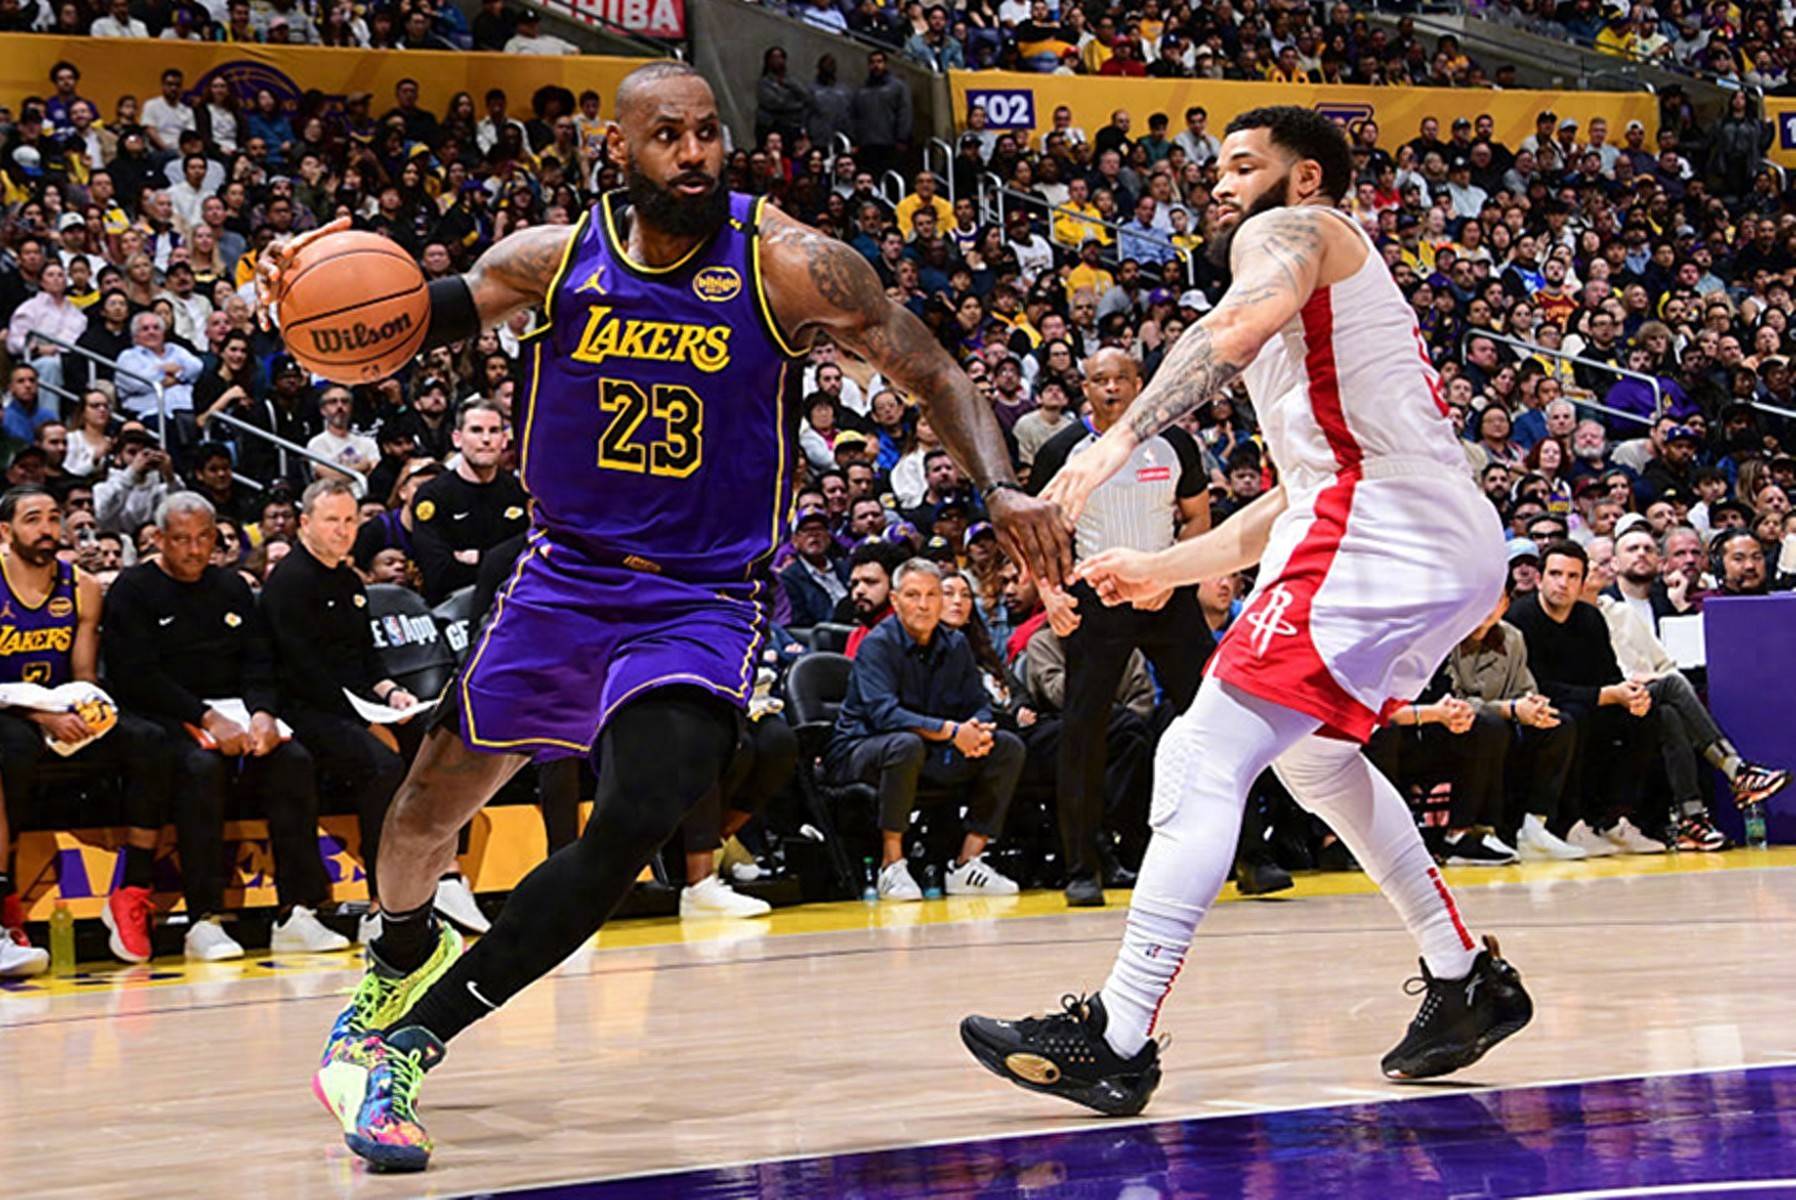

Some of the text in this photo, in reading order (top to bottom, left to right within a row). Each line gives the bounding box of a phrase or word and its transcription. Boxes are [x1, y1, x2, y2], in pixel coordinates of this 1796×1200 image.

[311, 312, 412, 353] Wilson
[571, 305, 732, 372] LAKERS
[597, 377, 703, 479] 23
[0, 625, 72, 656] LAKERS
